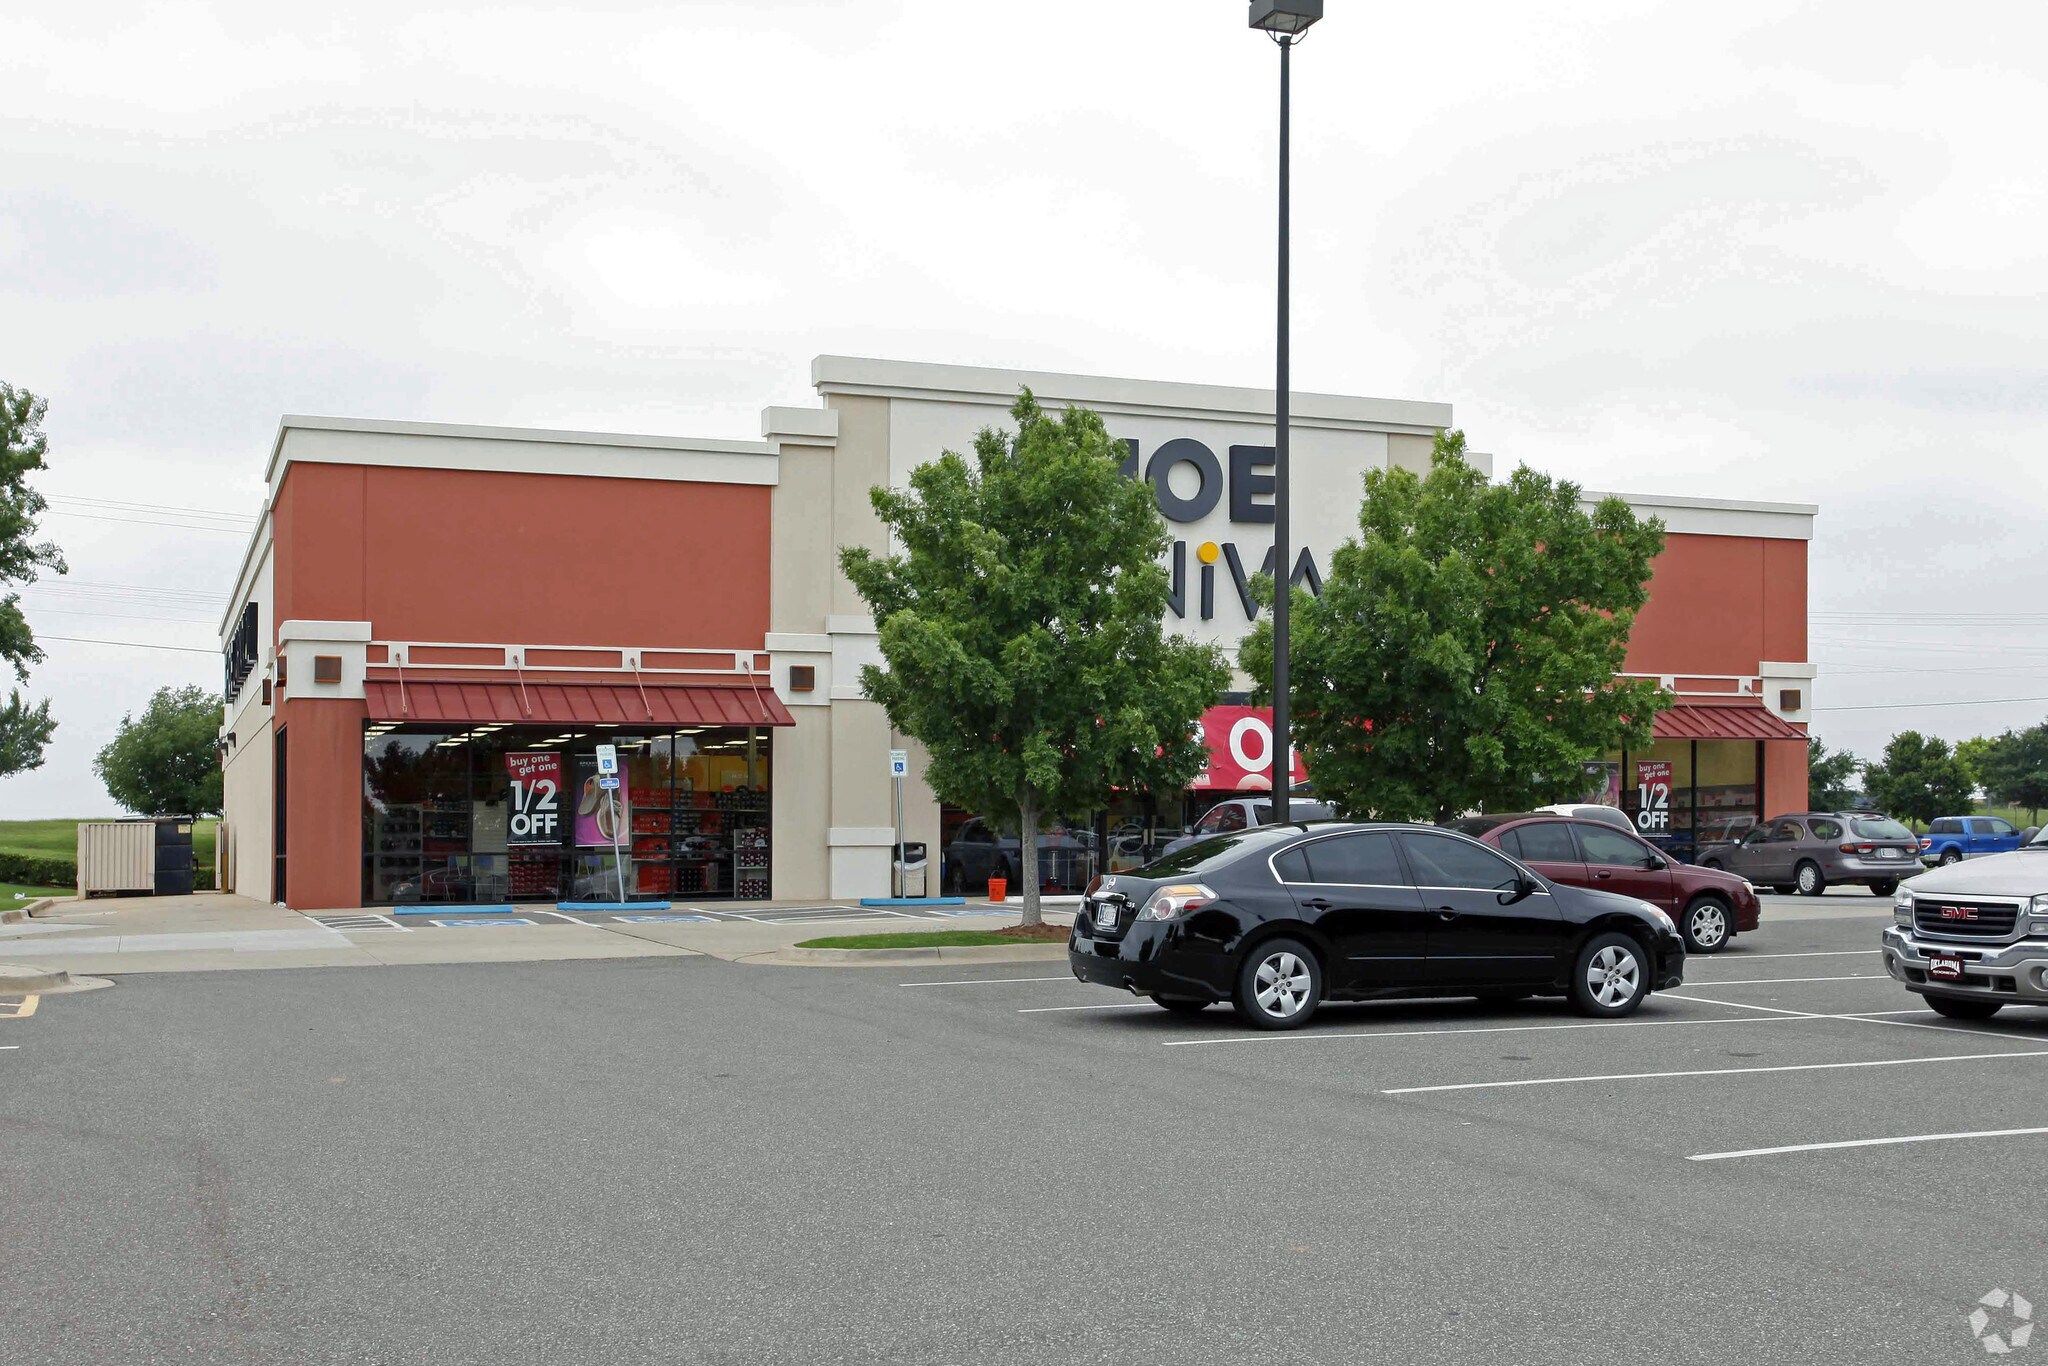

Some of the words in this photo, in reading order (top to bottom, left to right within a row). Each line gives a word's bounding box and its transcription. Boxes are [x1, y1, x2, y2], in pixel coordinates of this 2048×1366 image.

[510, 757, 528, 767] buy
[531, 755, 550, 763] one
[519, 764, 535, 776] get
[538, 762, 557, 771] one
[1645, 771, 1655, 780] get
[510, 779, 557, 813] 1/2
[1638, 783, 1668, 811] 1/2
[511, 813, 558, 835] OFF
[1638, 811, 1669, 829] OFF
[1941, 906, 1978, 920] GMC
[1930, 958, 1960, 974] OKLAHOMA
